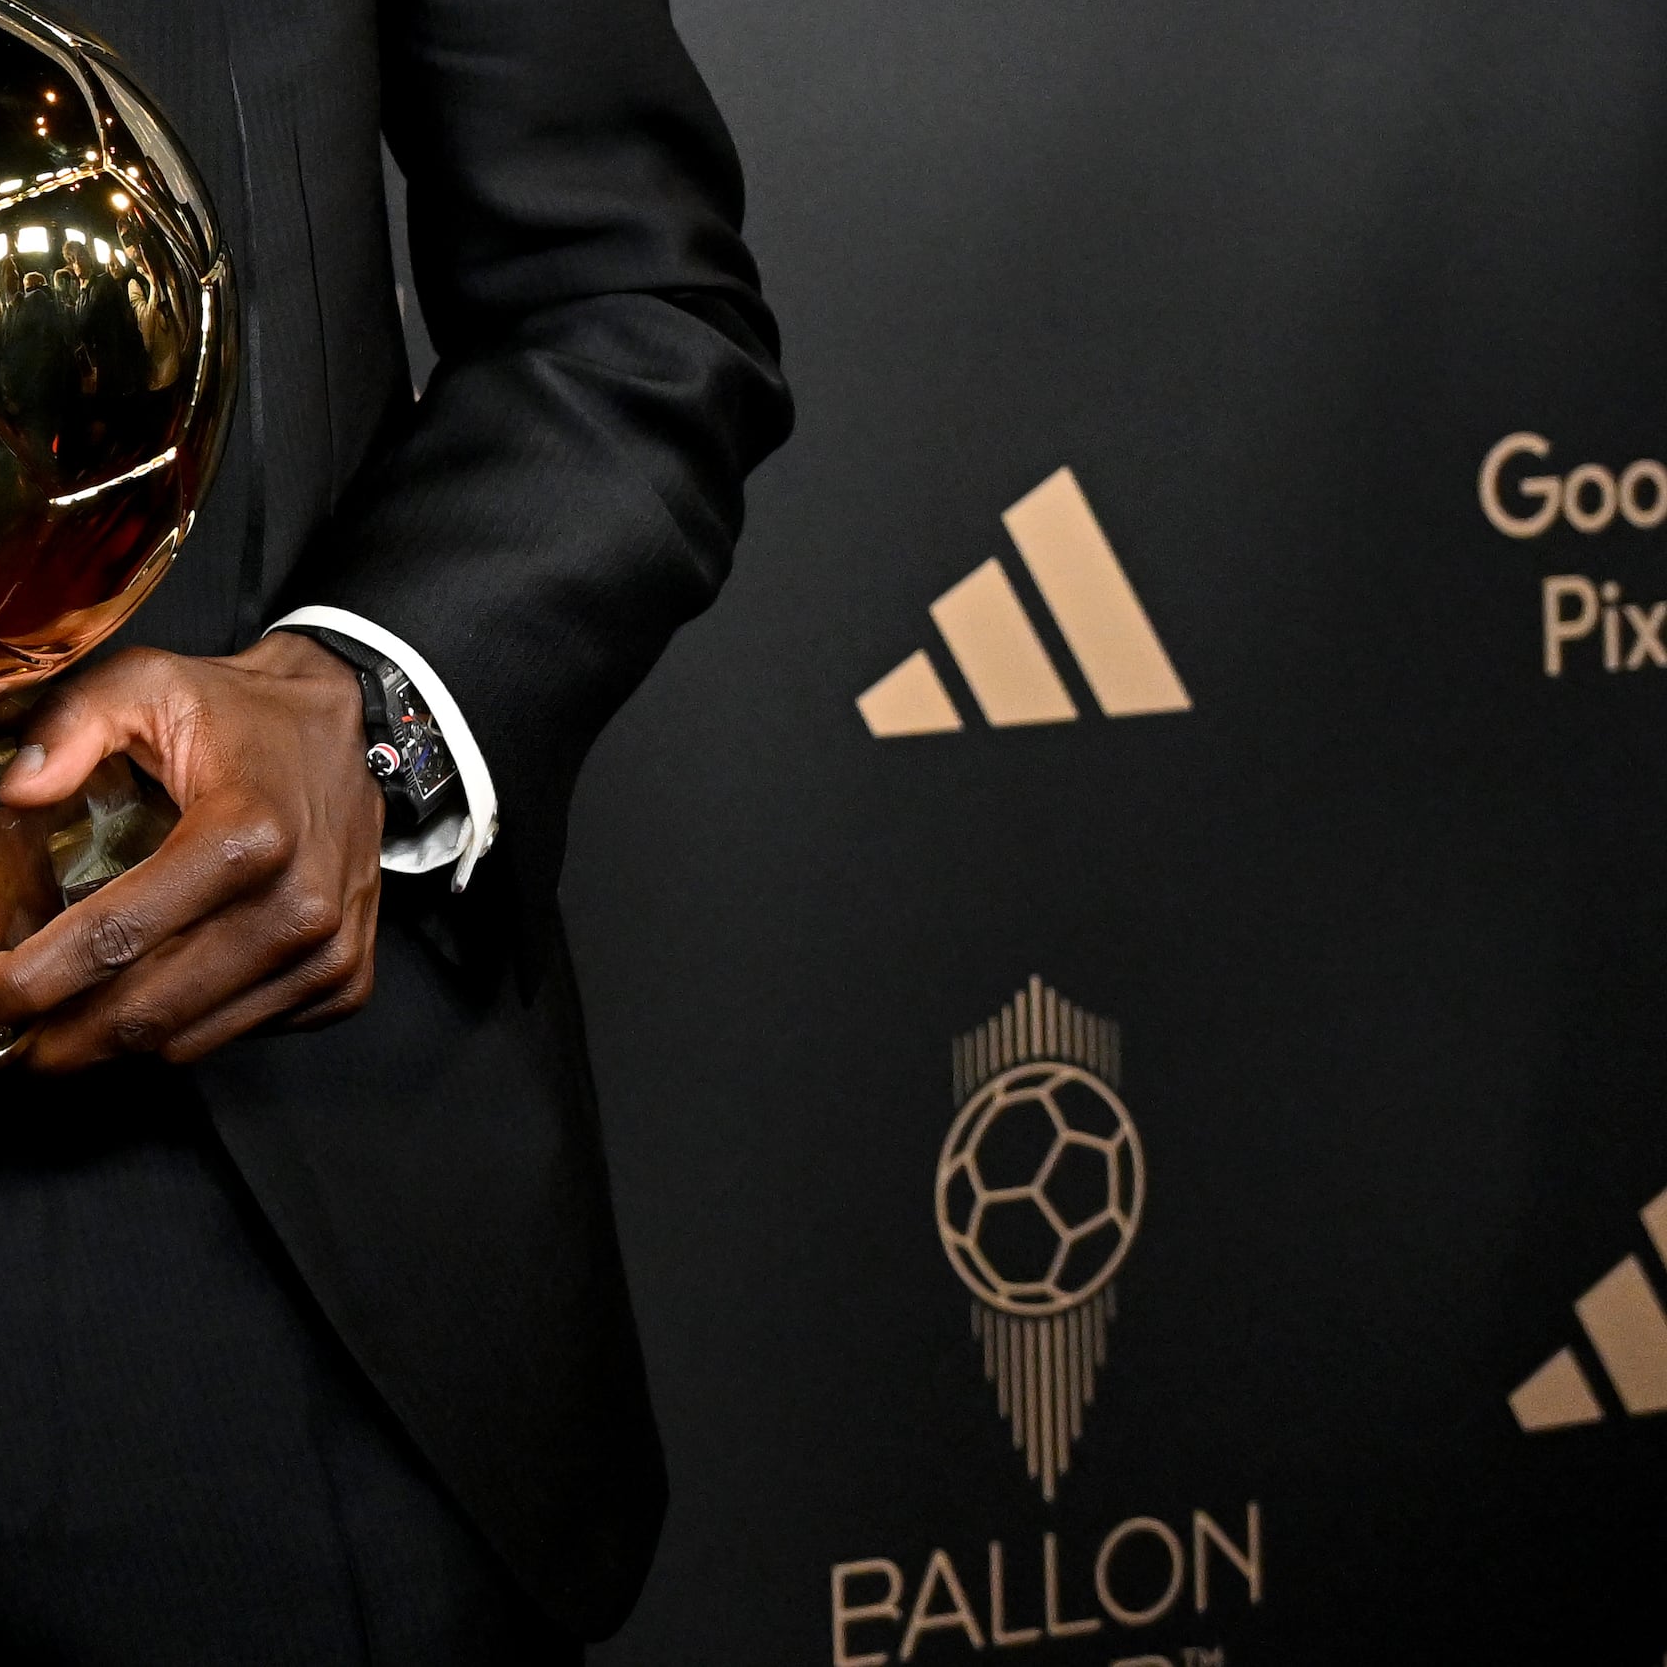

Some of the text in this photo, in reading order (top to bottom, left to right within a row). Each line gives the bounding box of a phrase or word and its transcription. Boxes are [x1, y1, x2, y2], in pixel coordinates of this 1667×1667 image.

[1478, 431, 1667, 540] Goo
[1541, 573, 1667, 679] Pix
[830, 1498, 1263, 1667] BALLON
